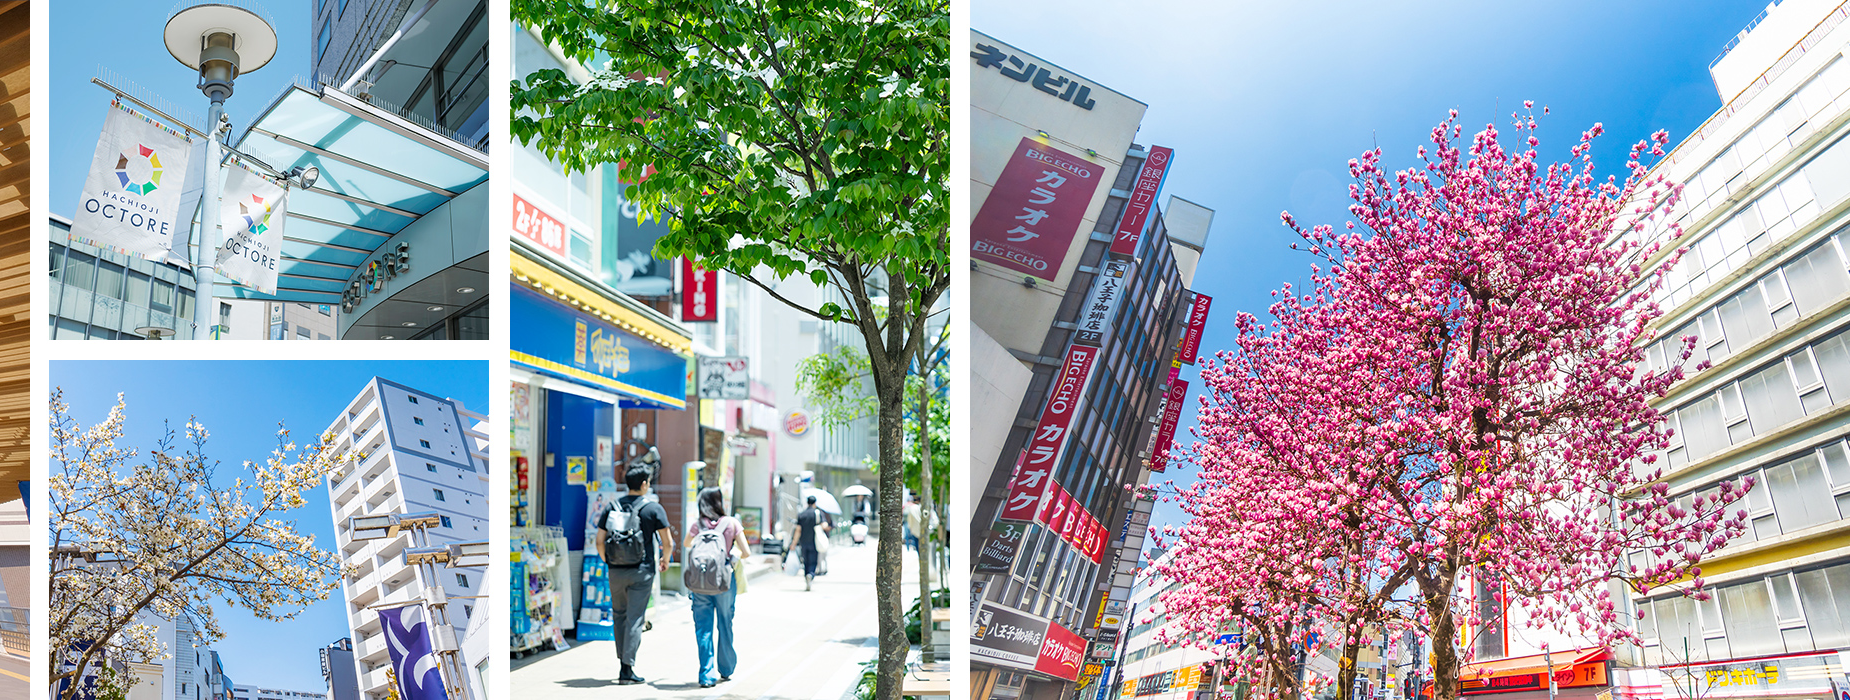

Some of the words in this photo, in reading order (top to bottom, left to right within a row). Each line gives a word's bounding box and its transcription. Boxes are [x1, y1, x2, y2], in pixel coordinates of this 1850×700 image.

[970, 42, 1096, 111] ネンビル
[1025, 148, 1054, 164] BIG
[1053, 160, 1091, 179] ECHO
[102, 190, 160, 215] HACHIOJI
[1006, 170, 1067, 242] カラオケ
[1130, 166, 1163, 226] 銀座カラー
[85, 198, 170, 236] OCTORE
[237, 230, 271, 252] HACHIOJI
[1119, 230, 1139, 243] 7F
[225, 237, 276, 271] OCTORE
[972, 240, 1005, 257] BIG
[1005, 251, 1048, 271] ECHO
[1084, 278, 1118, 331] 八王子珈琲店
[1191, 296, 1210, 327] カラオケ
[1080, 331, 1099, 341] 2F
[1069, 350, 1088, 376] BIG
[1051, 376, 1077, 415] ECHO
[1010, 423, 1065, 512] カラオケ
[991, 539, 1014, 553] Darts
[998, 524, 1022, 543] 3F
[983, 546, 1014, 564] Billiard
[987, 622, 1042, 646] 八王子珈琲店
[1001, 652, 1020, 661] COFFEE
[1041, 637, 1064, 660] カラオケ
[1583, 667, 1597, 681] 7F
